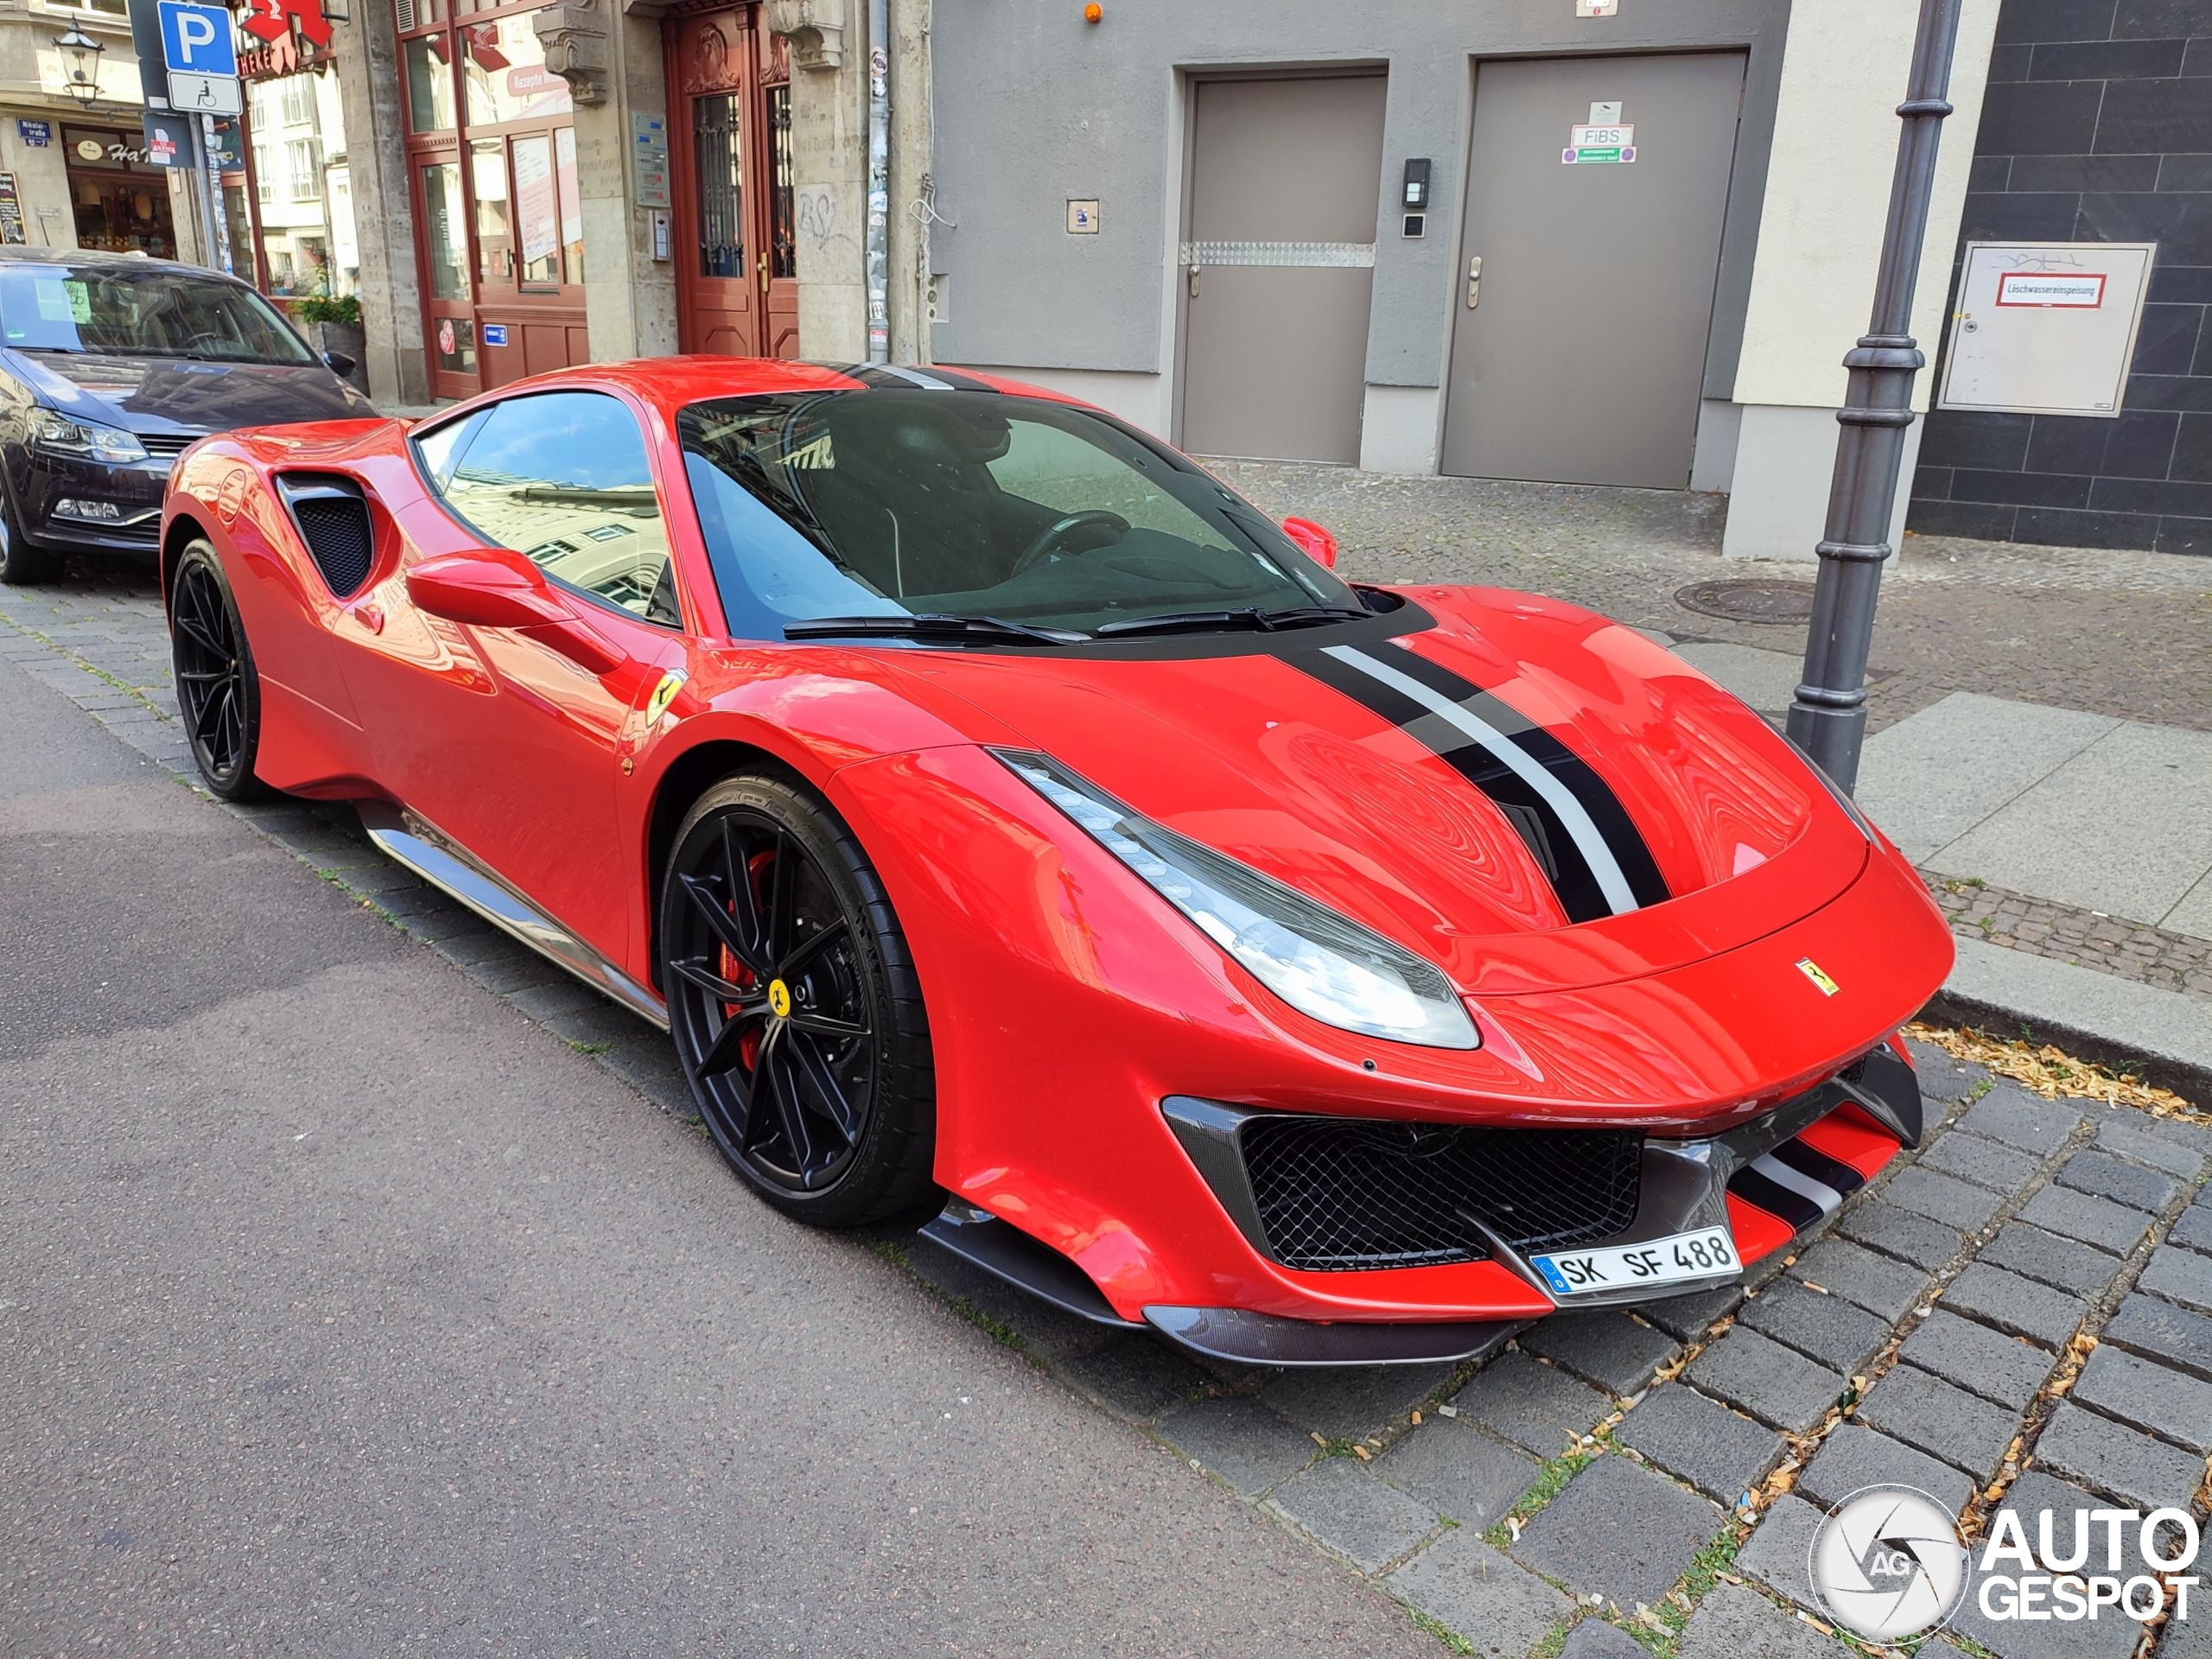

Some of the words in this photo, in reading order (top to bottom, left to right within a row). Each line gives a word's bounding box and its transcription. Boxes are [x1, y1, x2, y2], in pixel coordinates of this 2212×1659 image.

[176, 11, 215, 63] P
[514, 73, 543, 90] Rezepte
[2007, 283, 2095, 297] Löschwassereinspeisung
[1560, 1257, 1608, 1284] SK
[1623, 1249, 1663, 1277] SF
[1674, 1236, 1731, 1270] 488
